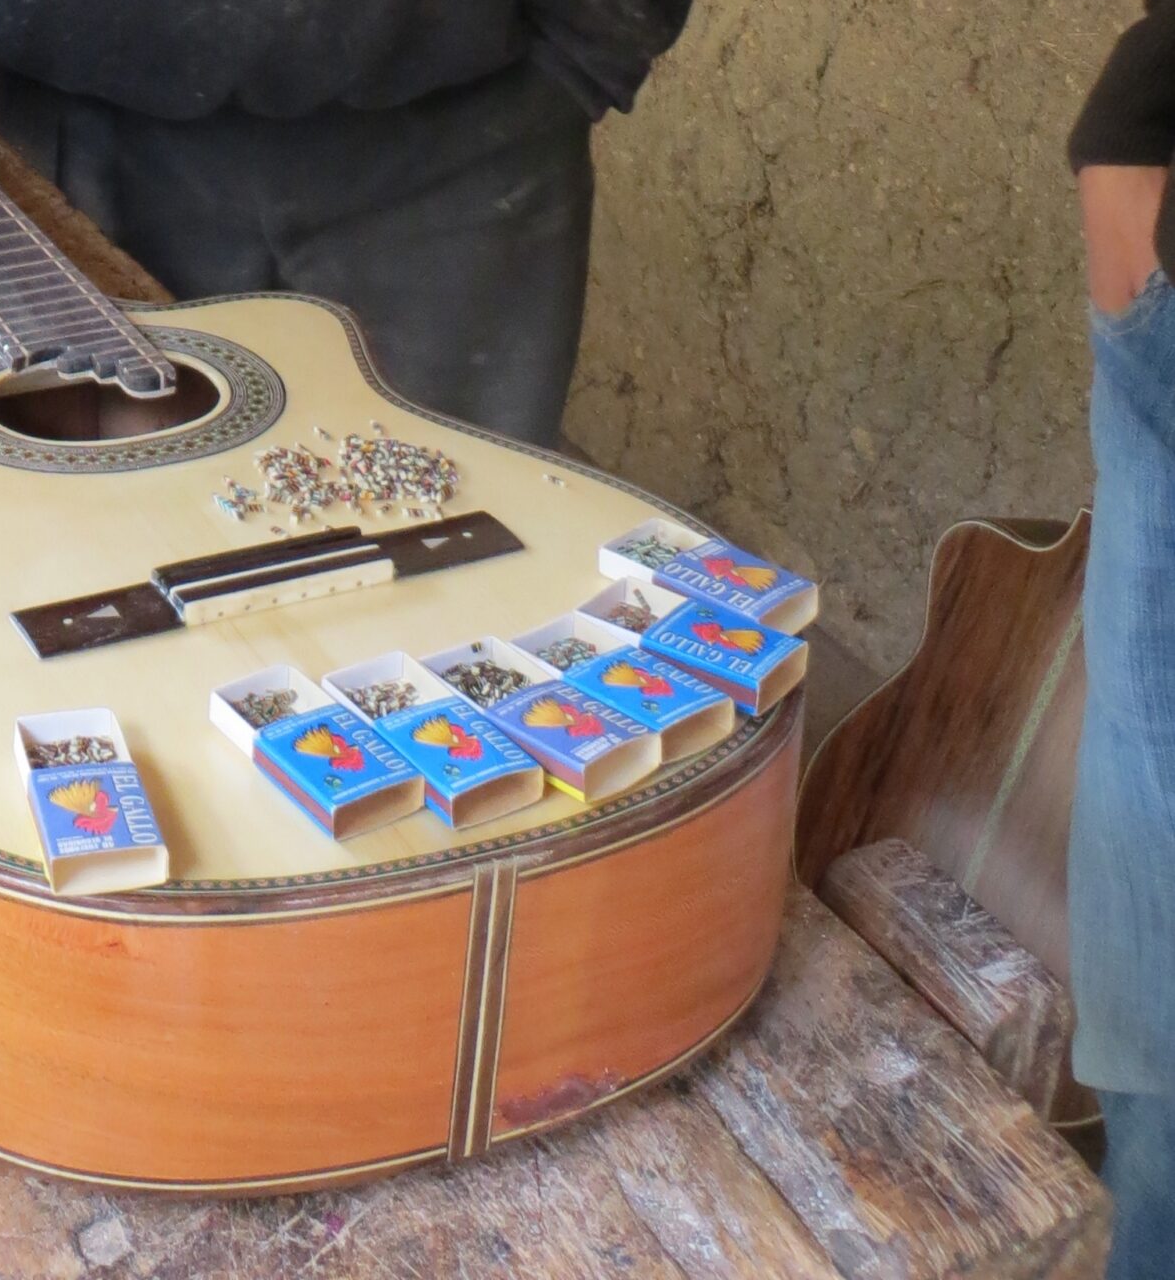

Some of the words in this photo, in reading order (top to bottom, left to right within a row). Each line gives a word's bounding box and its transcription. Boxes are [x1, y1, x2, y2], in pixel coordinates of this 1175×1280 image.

[664, 562, 726, 596] GALLO
[728, 590, 755, 609] EL
[659, 631, 723, 663] GALLO
[729, 655, 754, 673] EL
[629, 649, 653, 663] EL
[653, 661, 715, 694] GALLO
[555, 687, 584, 702] EL
[583, 700, 648, 734] GALLO
[331, 712, 356, 730] EL
[351, 729, 407, 770] GALLO
[449, 704, 476, 721] EL
[470, 720, 525, 760] GALLO
[111, 773, 140, 793] EL
[119, 795, 159, 844] GALLO
